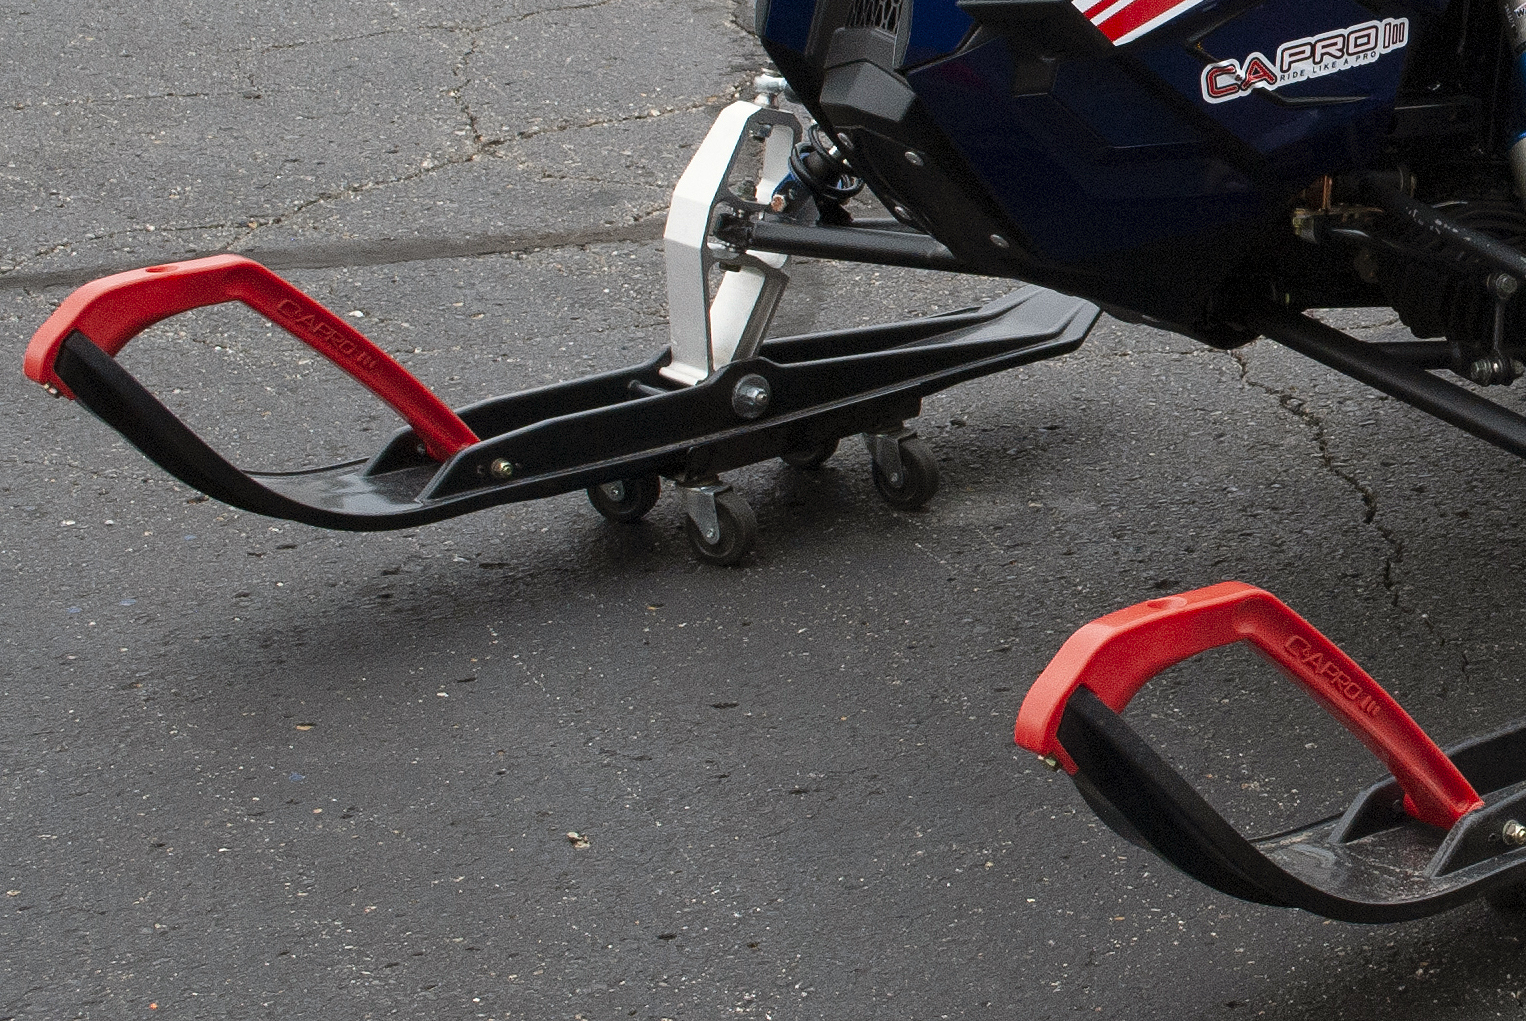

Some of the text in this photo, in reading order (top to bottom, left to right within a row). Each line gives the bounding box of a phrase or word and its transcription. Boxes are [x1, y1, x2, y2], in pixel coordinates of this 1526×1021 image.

[1280, 25, 1379, 73] PRO
[1280, 68, 1305, 82] RIDE
[1312, 61, 1337, 74] LIKE
[1355, 50, 1377, 63] PRO
